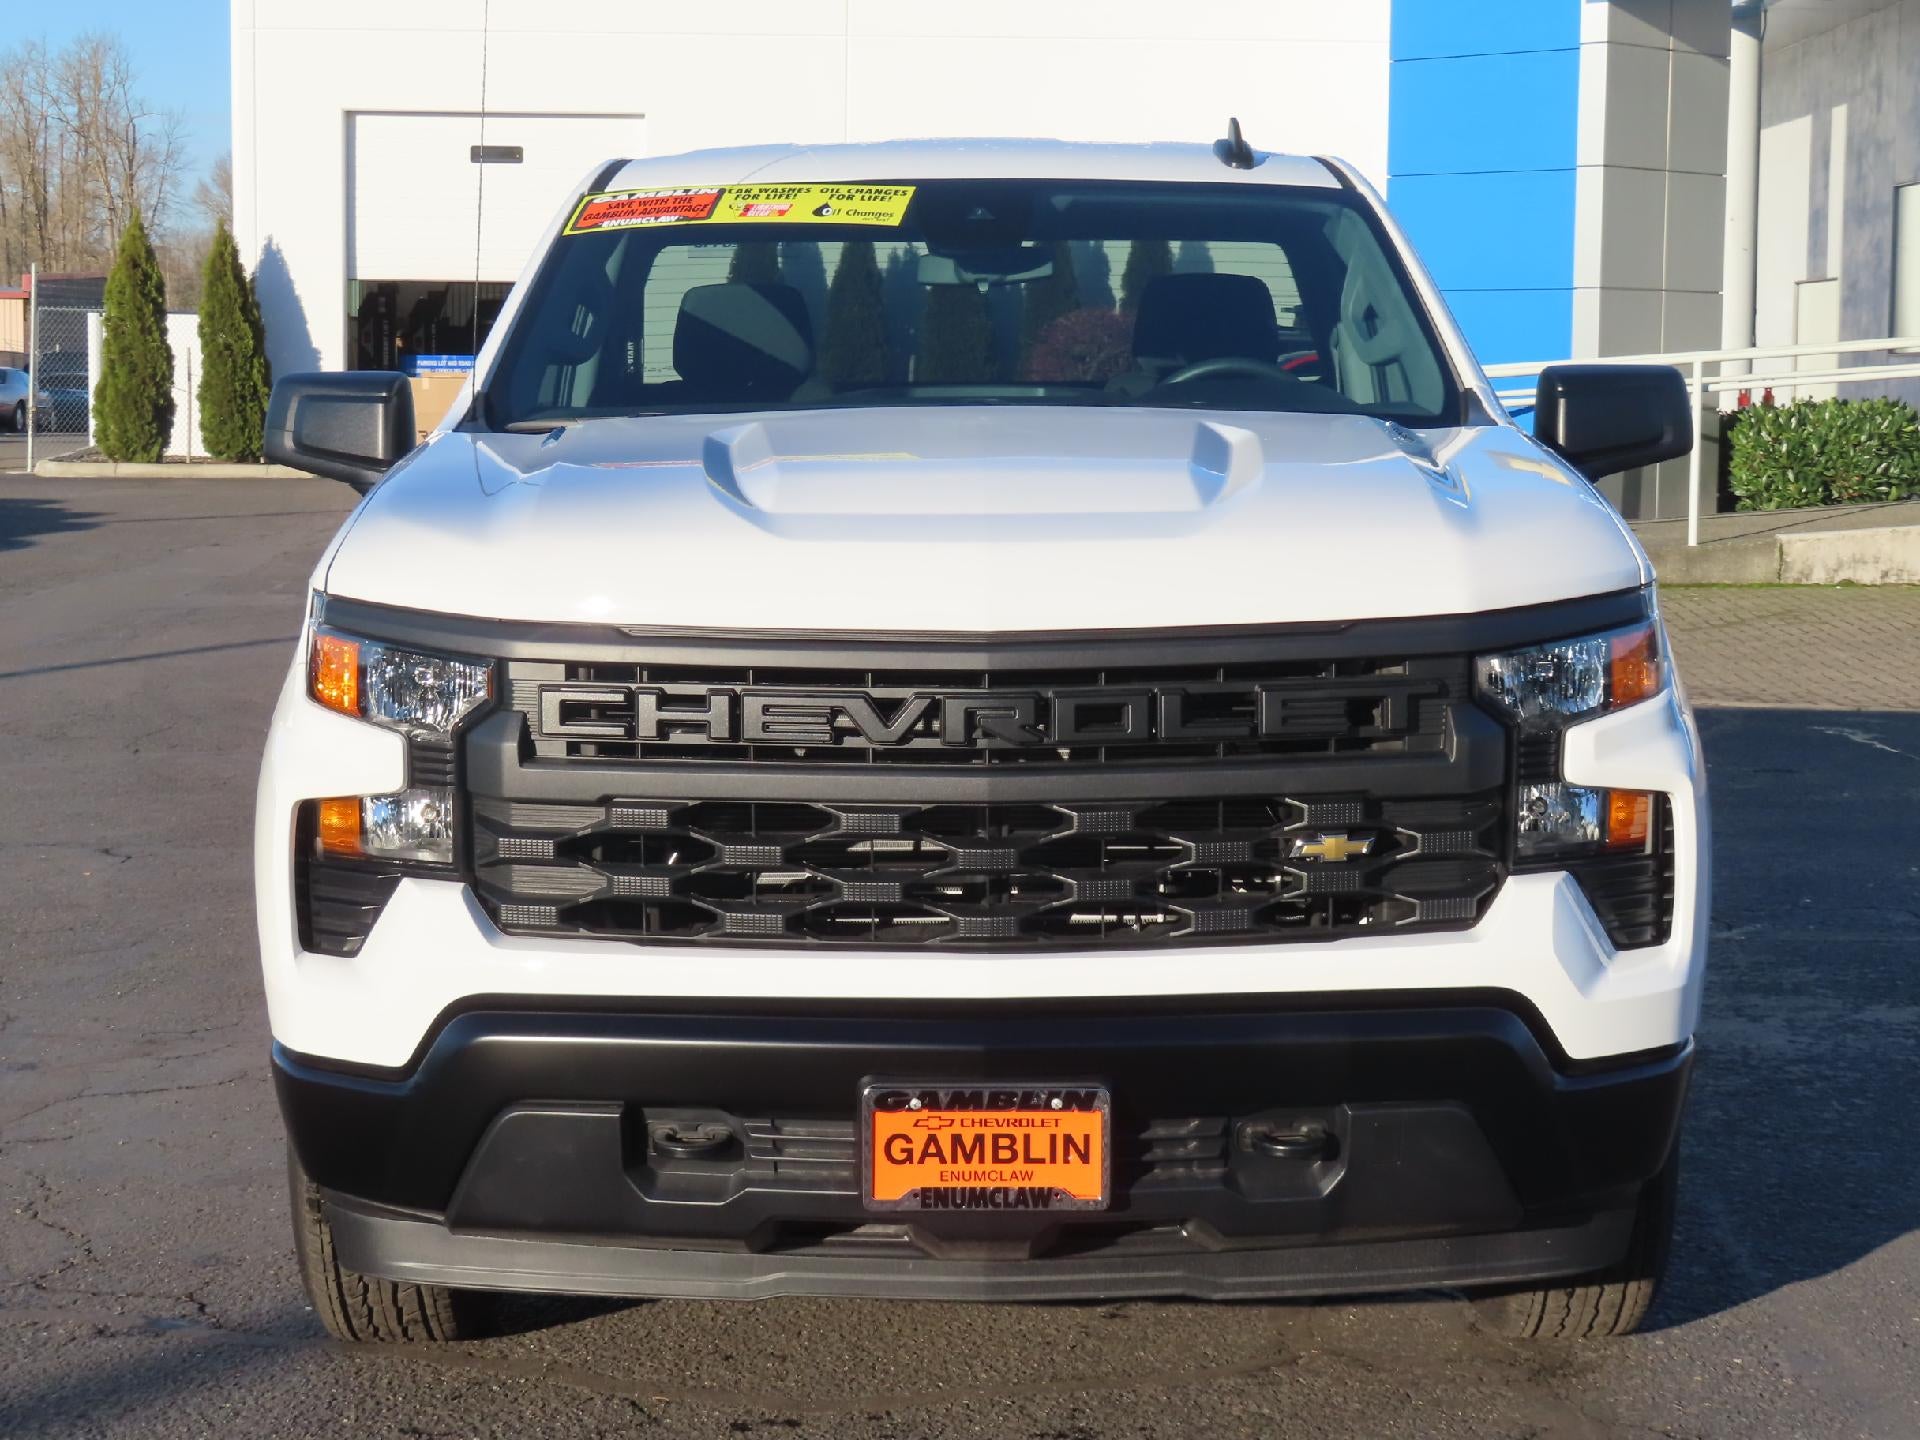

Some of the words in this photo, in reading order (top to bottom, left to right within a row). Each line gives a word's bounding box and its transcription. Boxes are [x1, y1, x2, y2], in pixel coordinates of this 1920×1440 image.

[828, 193, 856, 201] FOR
[860, 194, 893, 202] LIFE!
[846, 188, 908, 197] CHANGES
[606, 200, 634, 210] SAVE
[638, 198, 668, 208] WITH
[672, 196, 694, 205] THE
[583, 208, 638, 221] GAMBLIN
[639, 203, 709, 216] ADVANTAGE
[845, 208, 895, 219] Changes
[601, 215, 678, 228] ENUMCLAW
[538, 684, 1446, 746] CHEVROLET
[873, 1090, 1099, 1112] GAMBLIN
[960, 1118, 1062, 1128] CHEVROLET
[884, 1133, 1091, 1165] GAMBLIN
[940, 1170, 1034, 1182] ENUMCLAW
[920, 1186, 1055, 1209] ENUMCLAW
